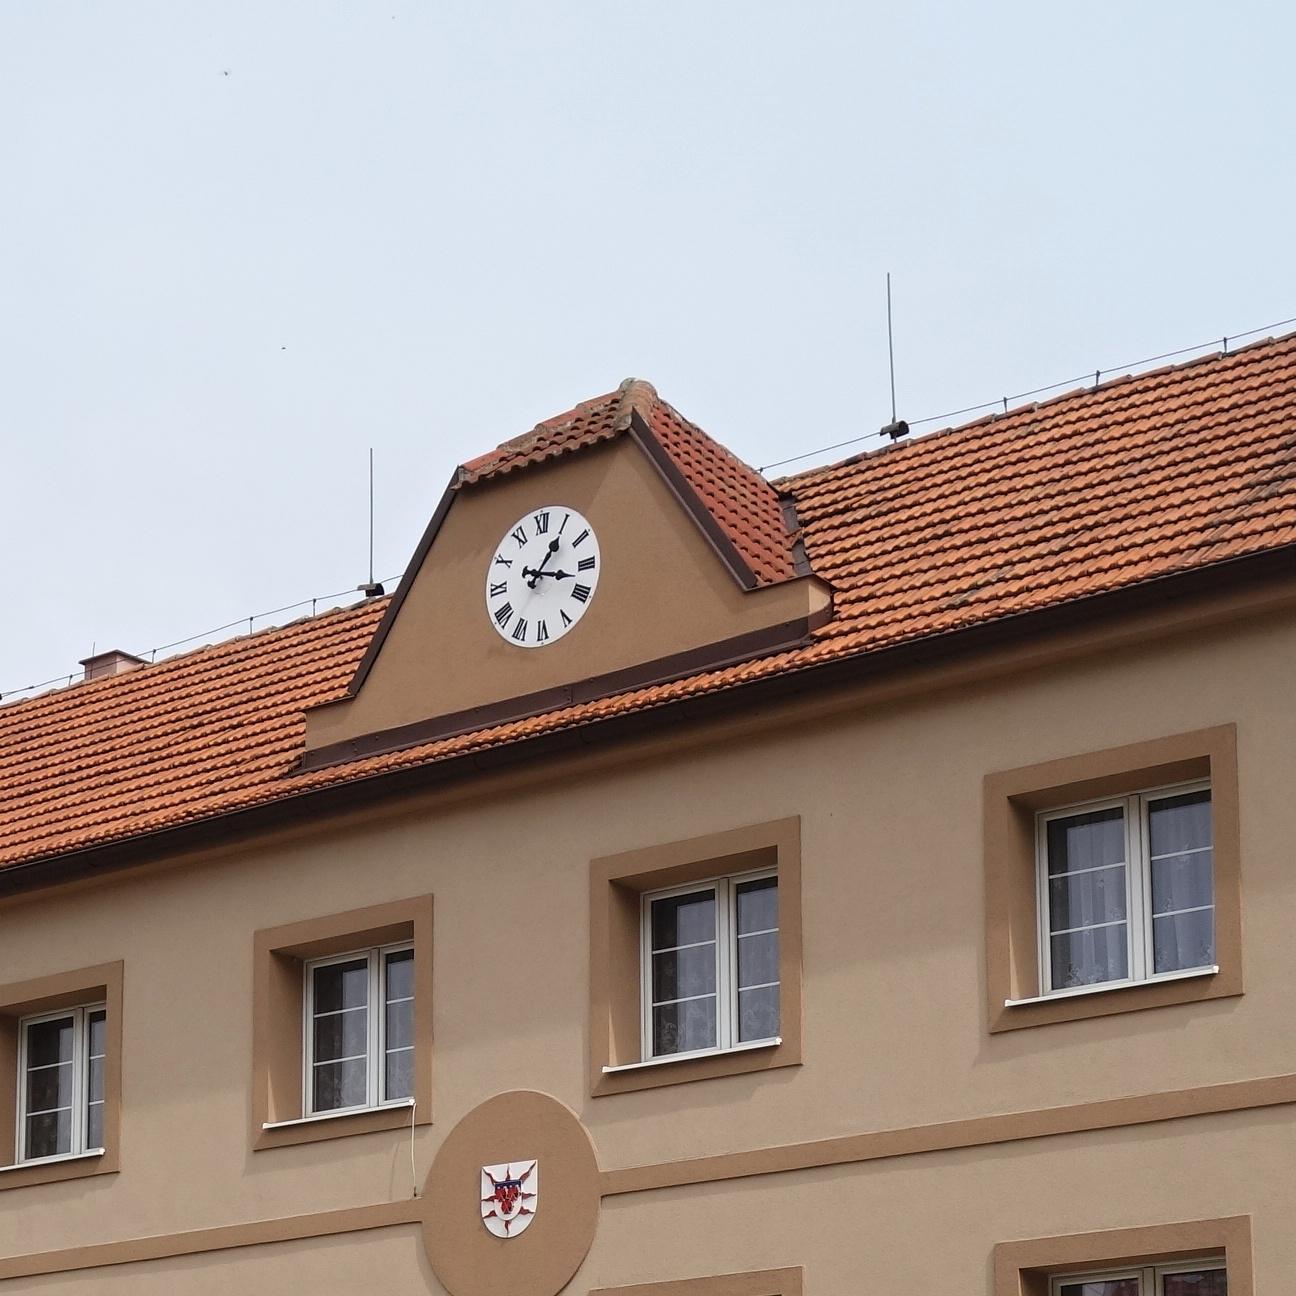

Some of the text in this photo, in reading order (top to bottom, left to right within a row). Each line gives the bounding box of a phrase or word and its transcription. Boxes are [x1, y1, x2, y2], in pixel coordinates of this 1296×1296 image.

[534, 512, 550, 535] XII
[559, 514, 570, 535] I
[511, 525, 528, 549] XI
[572, 530, 590, 547] II
[496, 554, 513, 568] X
[577, 556, 596, 572] III
[490, 581, 507, 597] IX
[494, 602, 514, 629] VIII
[560, 609, 572, 628] V
[512, 618, 528, 642] VII
[537, 620, 549, 642] VI
